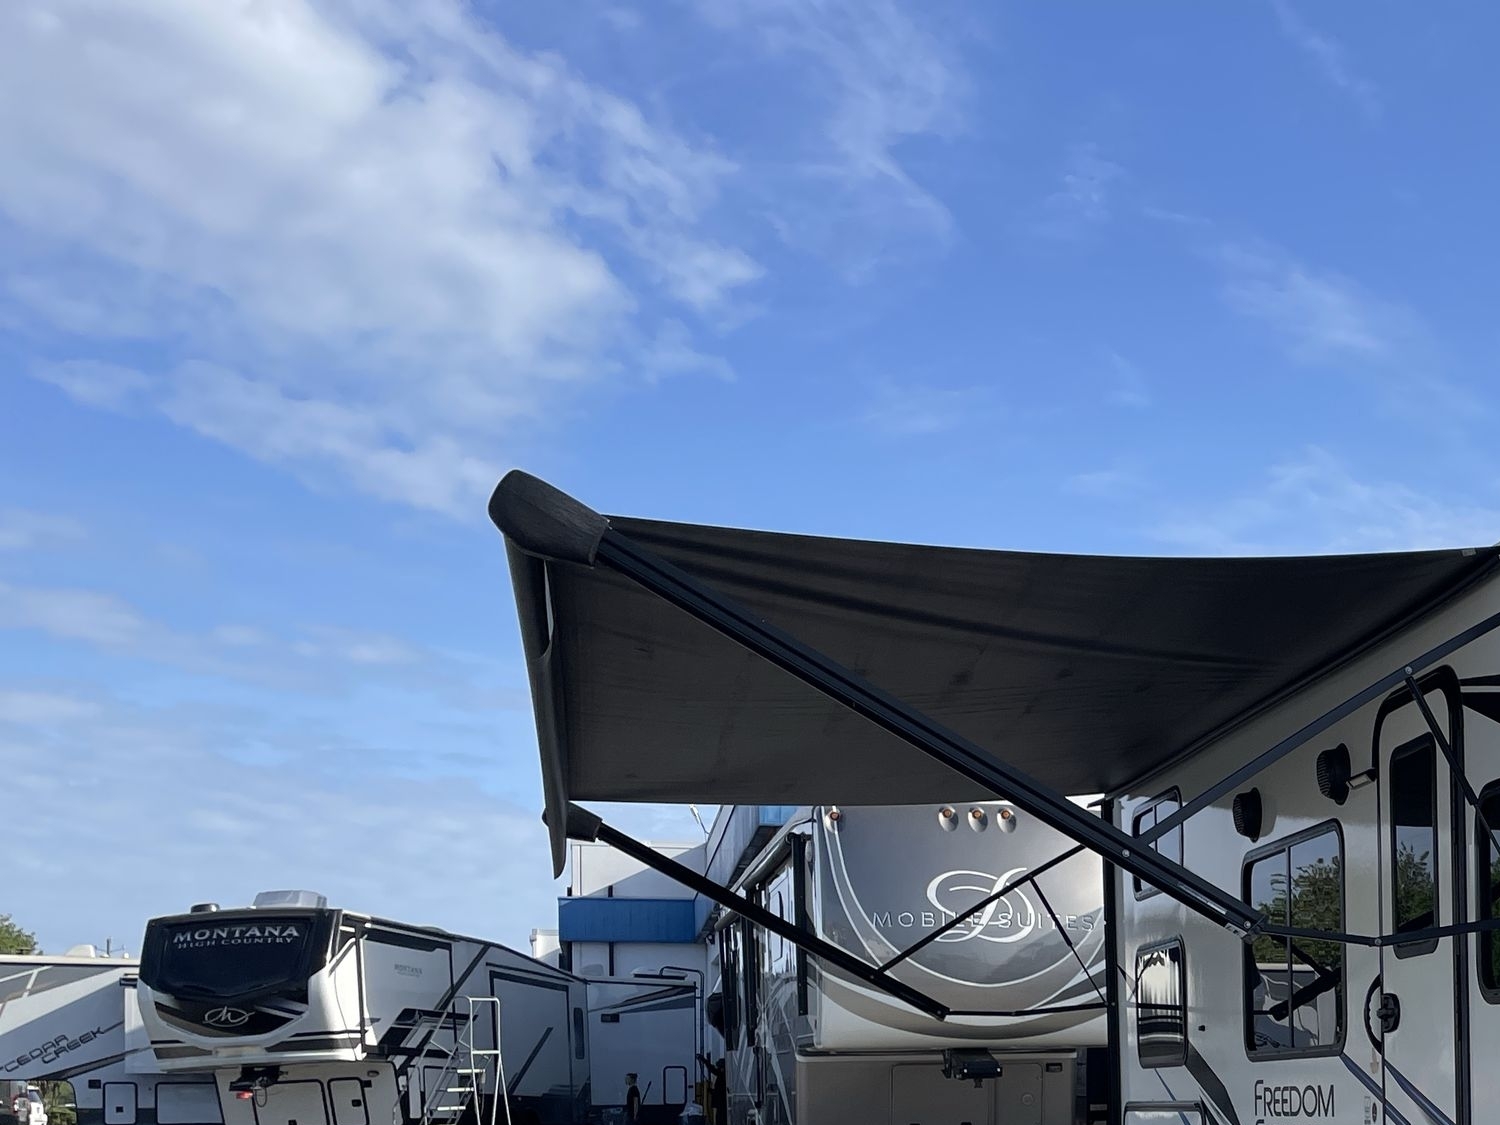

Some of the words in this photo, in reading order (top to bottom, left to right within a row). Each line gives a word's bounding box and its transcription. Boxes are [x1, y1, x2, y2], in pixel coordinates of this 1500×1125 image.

[173, 926, 299, 943] MONTANA
[998, 912, 1095, 932] SUITES
[178, 940, 216, 949] HIGH
[221, 937, 293, 945] COUNTRY
[5, 1034, 69, 1073] CEDAR
[42, 1026, 105, 1064] CREEK
[1254, 1079, 1335, 1118] FREEDOM
